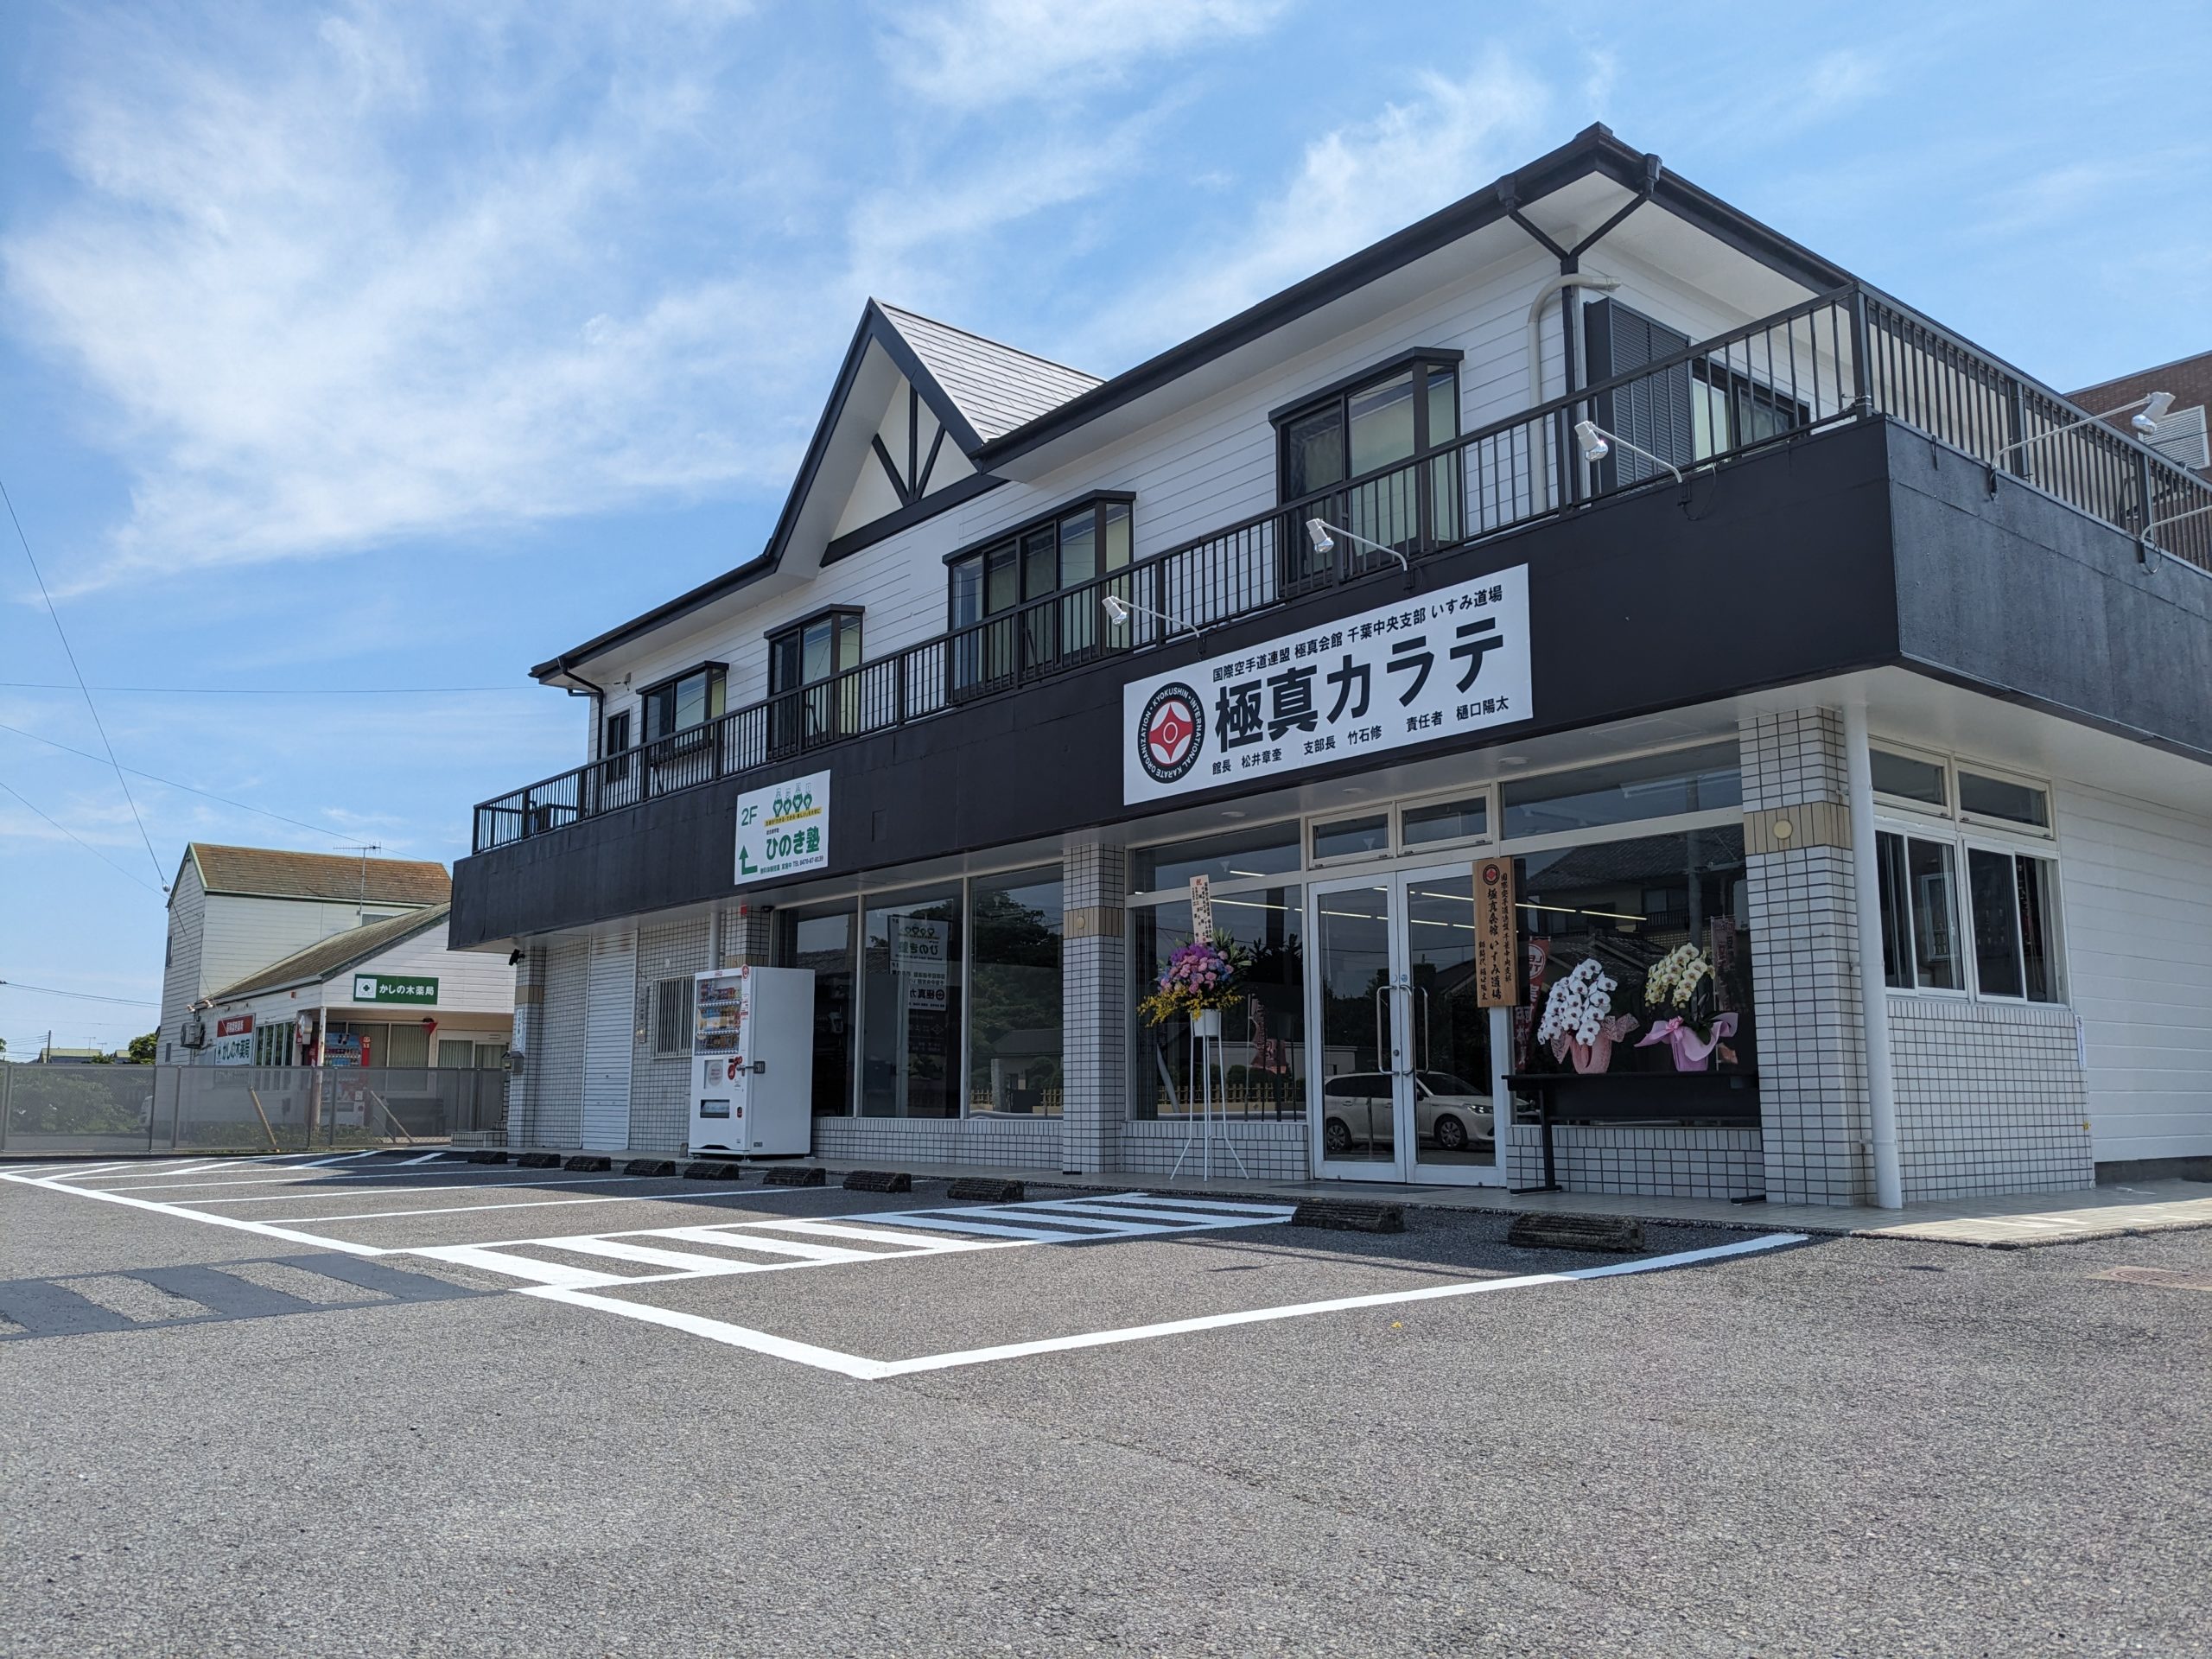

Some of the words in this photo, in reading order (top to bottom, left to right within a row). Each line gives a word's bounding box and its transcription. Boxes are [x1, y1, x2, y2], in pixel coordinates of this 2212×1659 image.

[1213, 646, 1290, 683] 国際空手道連盟
[1294, 632, 1343, 659] 極真会館
[1347, 607, 1426, 643] 千葉中央支部
[1431, 584, 1503, 619] いすみ道場
[1152, 687, 1189, 708] KYOKUSHIN
[1215, 617, 1503, 753] 極真カラテ
[1140, 710, 1156, 773] ORGANIZATION
[1181, 698, 1202, 767] INTERNATIONAL
[1212, 759, 1231, 775] 館長
[1241, 747, 1282, 769] 松井章奎
[1303, 735, 1336, 755] 支部長
[1347, 725, 1382, 745] 竹石修
[1406, 710, 1443, 733] 責任者
[1456, 695, 1510, 721] 樋口陽太
[1156, 766, 1183, 779] KARATE
[741, 805, 758, 826] 2F
[766, 826, 820, 860] ひのき塾
[1487, 888, 1498, 938] 極真会館
[379, 984, 435, 996] かしの木薬局
[1490, 939, 1502, 1000] いすみ道場
